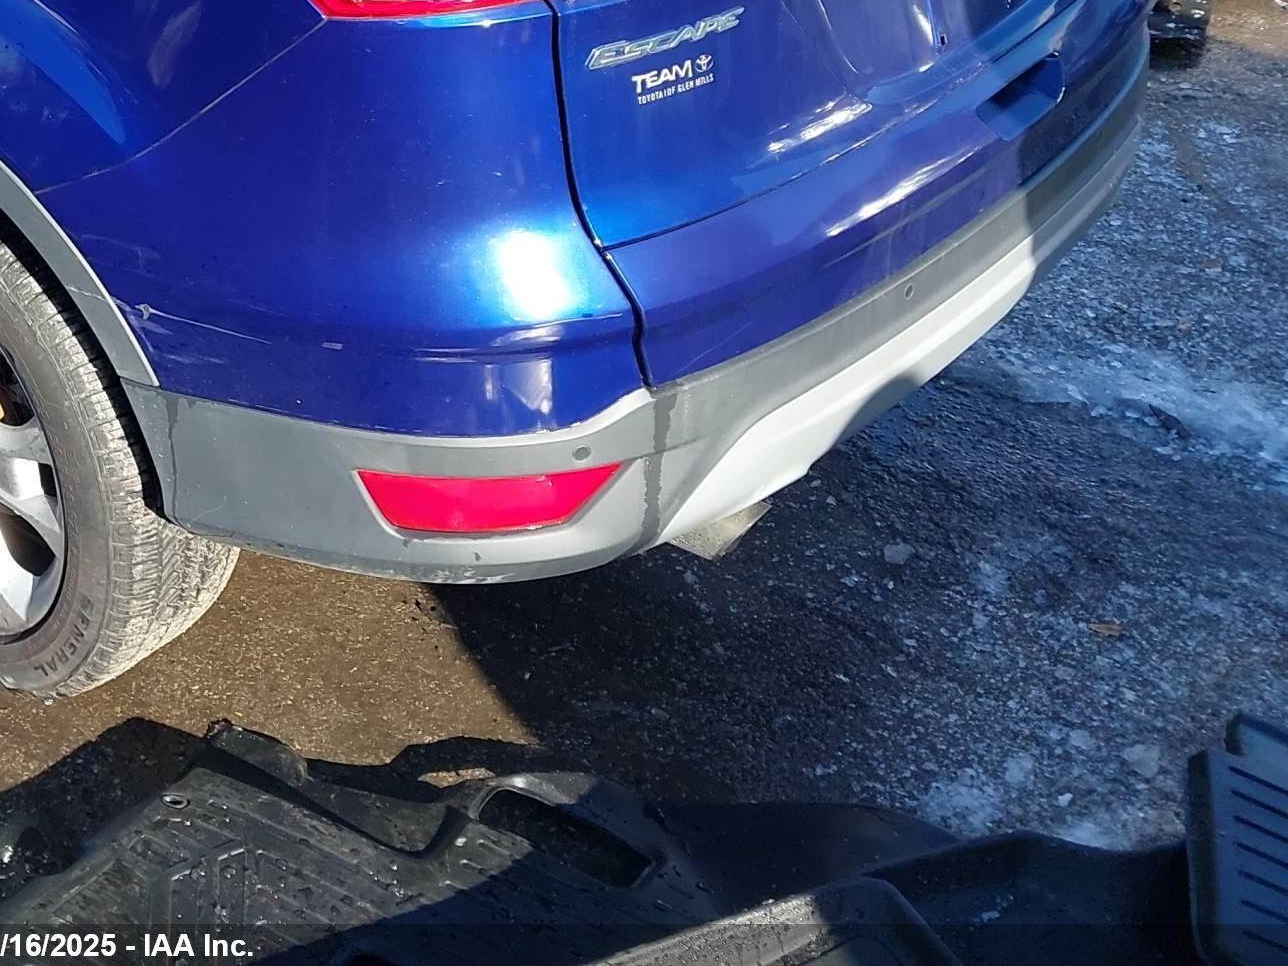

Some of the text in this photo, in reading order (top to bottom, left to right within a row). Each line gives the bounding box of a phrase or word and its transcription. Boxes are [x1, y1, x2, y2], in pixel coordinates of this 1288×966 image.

[631, 60, 693, 94] TEAM
[637, 90, 663, 105] TOYOTA
[677, 81, 695, 94] GLEN
[695, 73, 714, 87] MILLS
